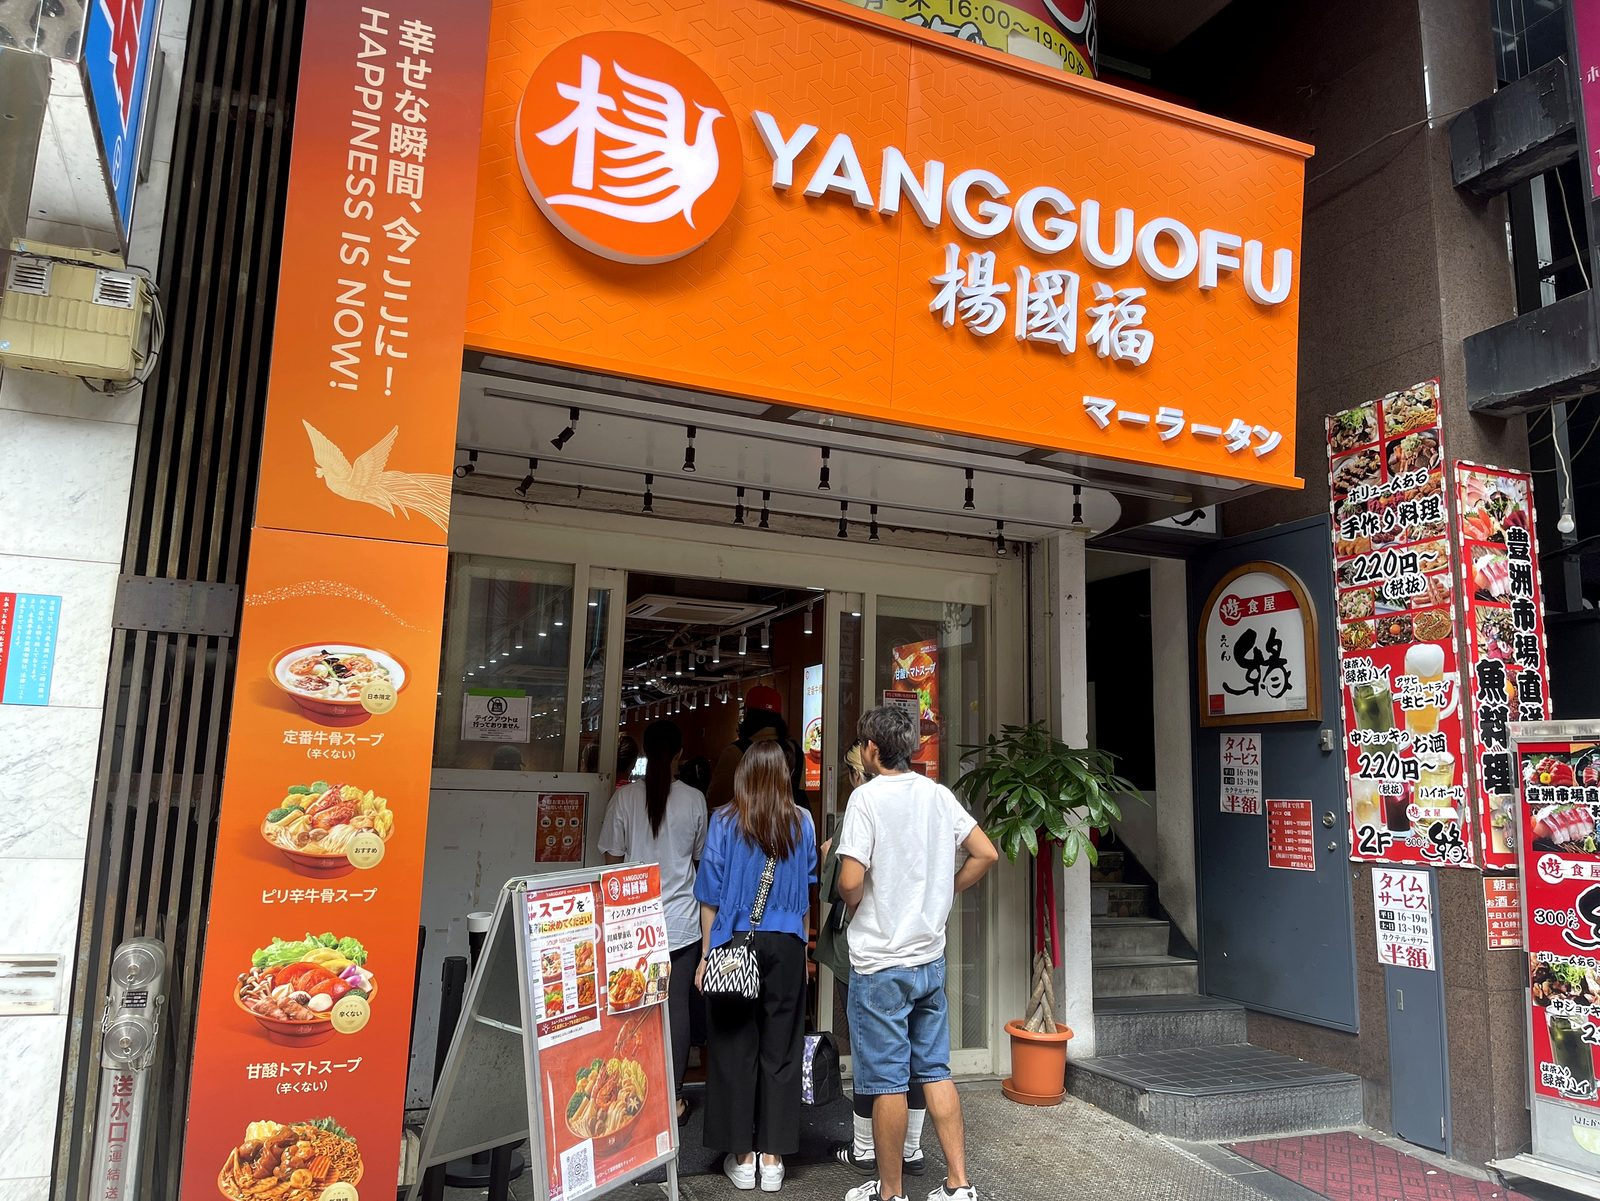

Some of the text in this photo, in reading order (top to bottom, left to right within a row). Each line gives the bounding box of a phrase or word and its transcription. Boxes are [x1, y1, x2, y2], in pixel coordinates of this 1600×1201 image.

[329, 6, 390, 391] HAPPINESS IS NOW!
[751, 110, 1293, 305] YANGGUOFU
[928, 243, 1154, 366] 楊國福
[1082, 395, 1282, 457] マーラータン
[1342, 496, 1441, 539] 手作り料理
[1220, 596, 1276, 620] 遊食屋
[1346, 666, 1390, 683] 緑茶ハイ
[1396, 677, 1418, 686] アサヒ
[366, 693, 391, 702] 日本限定
[1402, 694, 1446, 709] 生ビール
[472, 721, 520, 730] 行っておりません
[474, 714, 518, 723] テイクアウトは
[1477, 659, 1511, 796] 魚料理
[282, 729, 385, 748] 定番牛骨スープ
[1225, 737, 1256, 752] タイム
[1413, 734, 1446, 753] お酒
[306, 748, 356, 761] (辛くない)
[1224, 752, 1259, 765] サービス
[1226, 795, 1257, 813] 半額
[1359, 826, 1391, 853] 2F
[354, 846, 378, 855] おすすめ
[622, 872, 649, 882] YANGGUOFU
[1380, 873, 1423, 892] タイム
[261, 887, 378, 905] ピリ辛牛骨スープ
[1378, 891, 1427, 910] サービス
[540, 896, 585, 918] スープを
[611, 902, 659, 920] インスタフォローで
[1379, 910, 1393, 919] 平日
[1535, 910, 1566, 926] 300
[1384, 943, 1429, 968] 半額
[245, 1057, 363, 1079] 甘酸トマトスープ
[276, 1080, 328, 1095] (辛くない)
